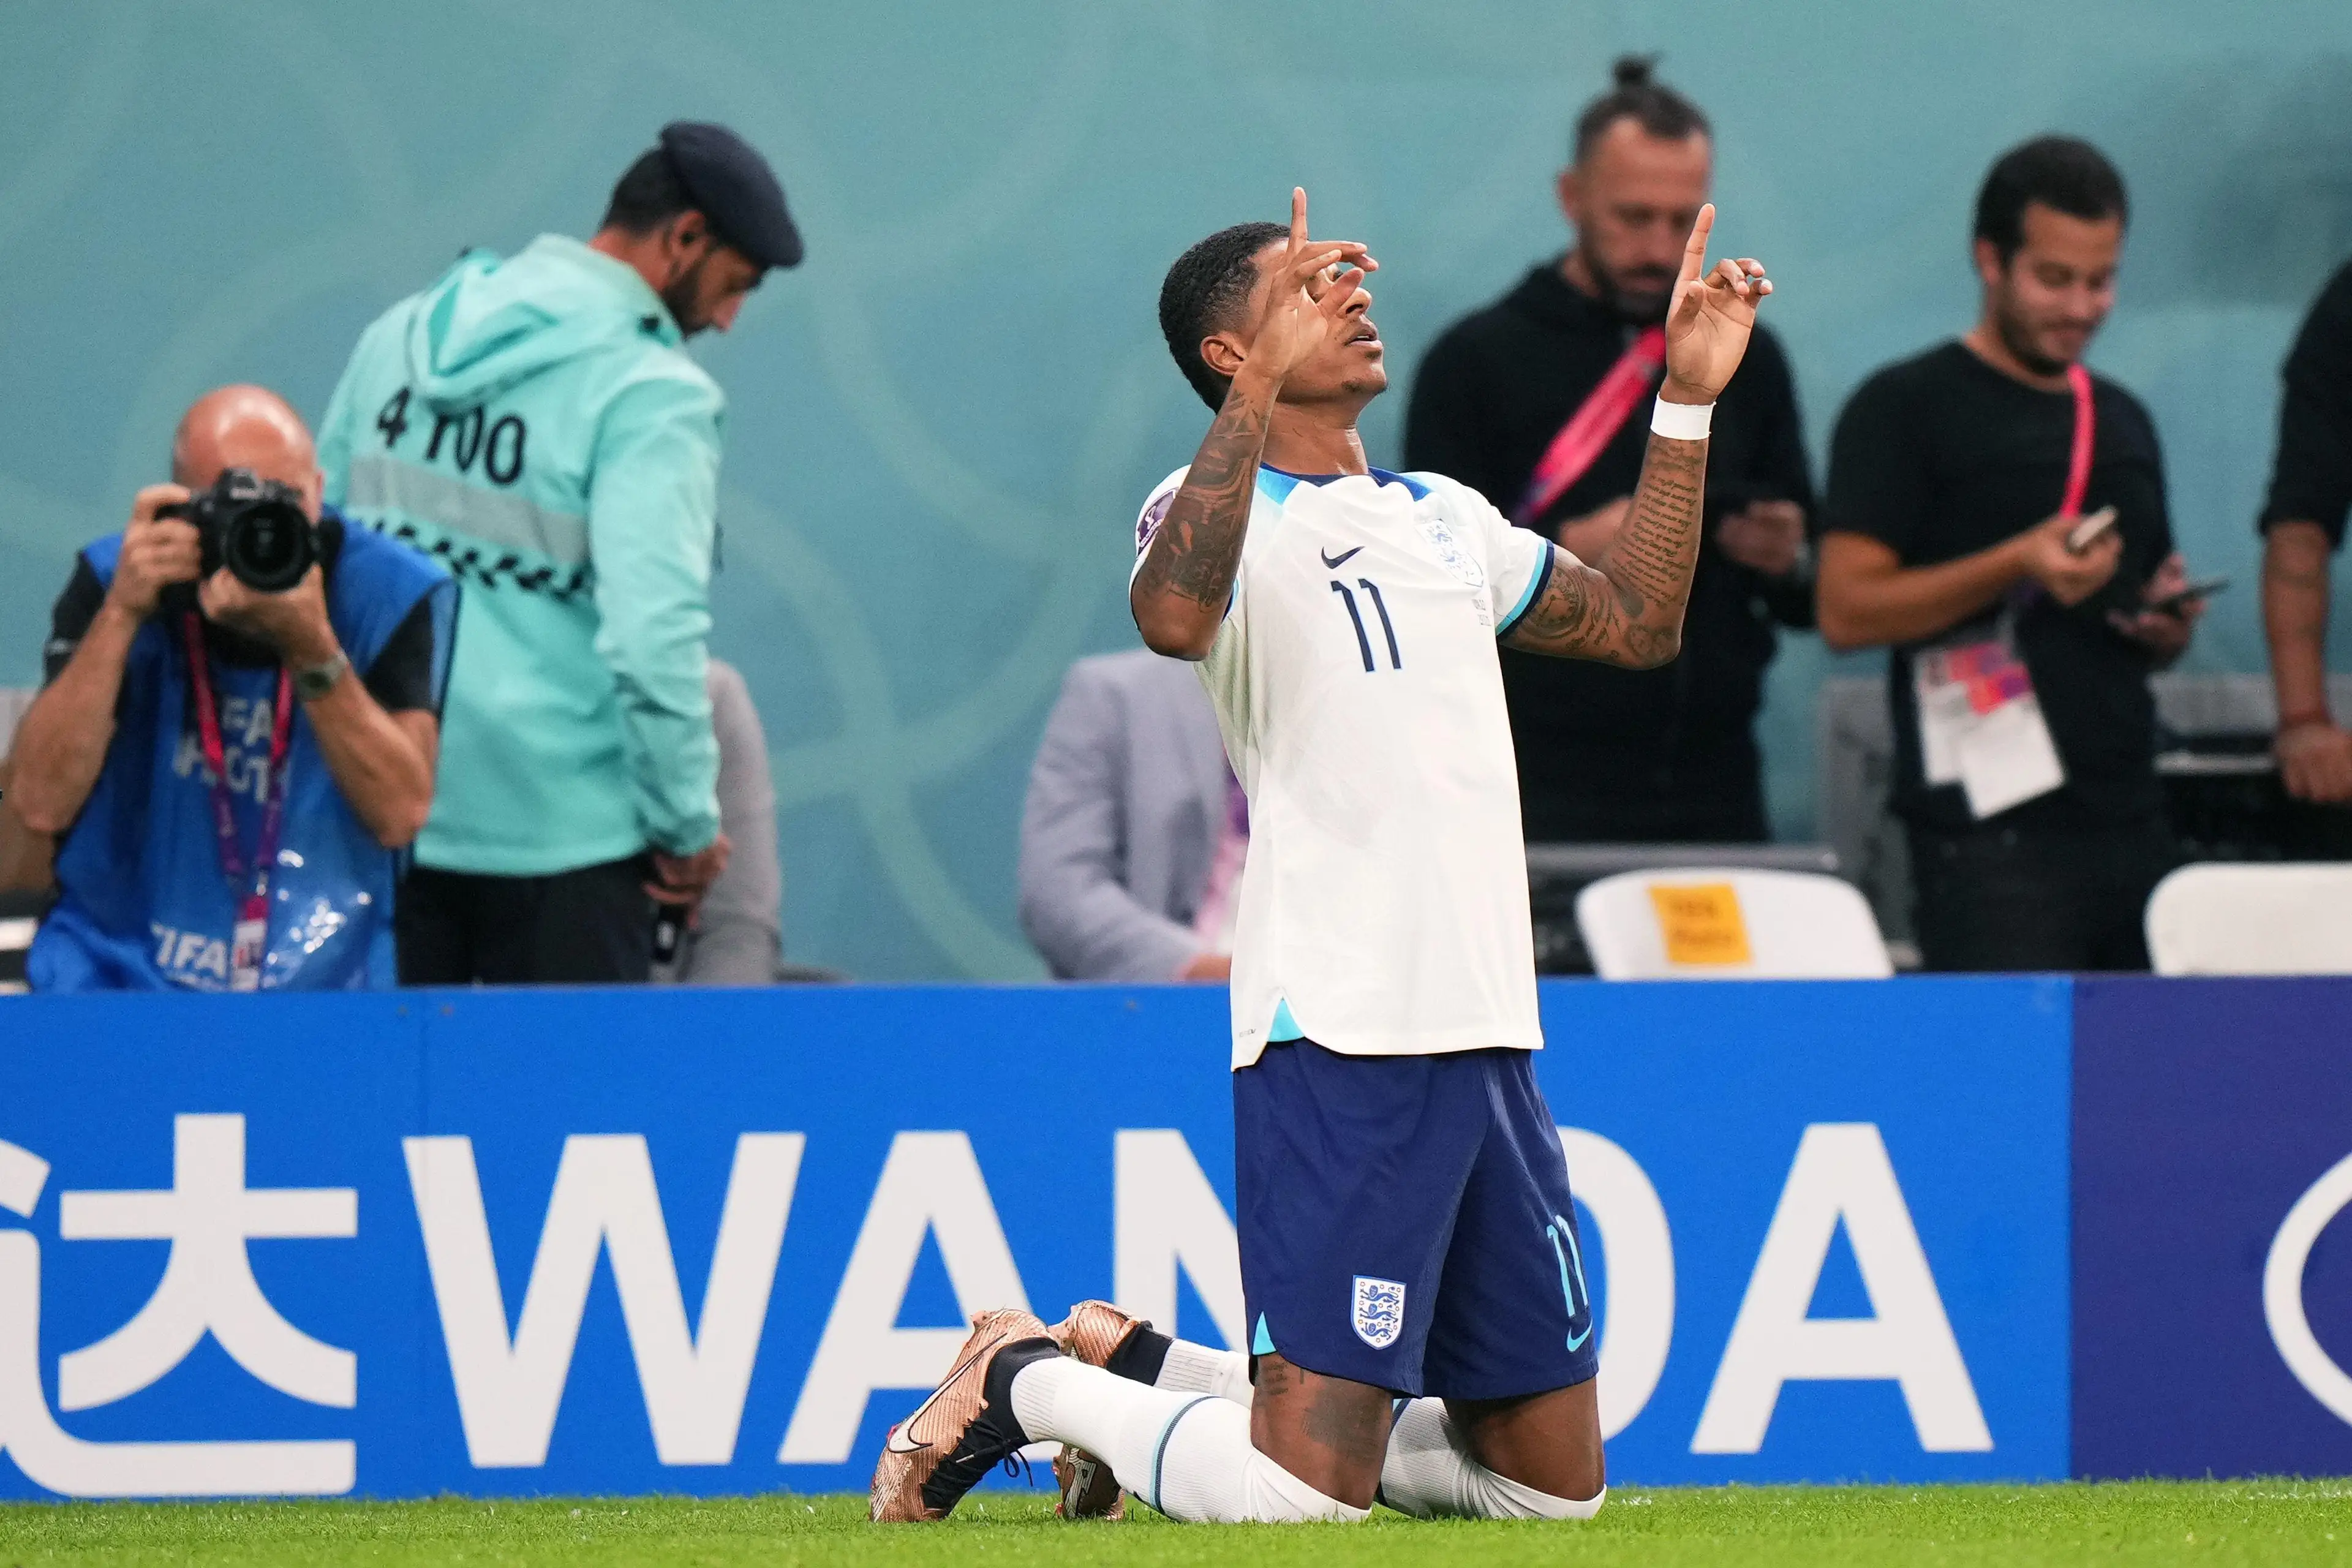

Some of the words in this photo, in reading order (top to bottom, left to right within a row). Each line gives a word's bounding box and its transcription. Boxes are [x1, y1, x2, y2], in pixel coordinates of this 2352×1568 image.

[1330, 578, 1402, 673] 11
[151, 922, 228, 978] IFA
[0, 1112, 359, 1499] 达
[1547, 1214, 1589, 1319] 11
